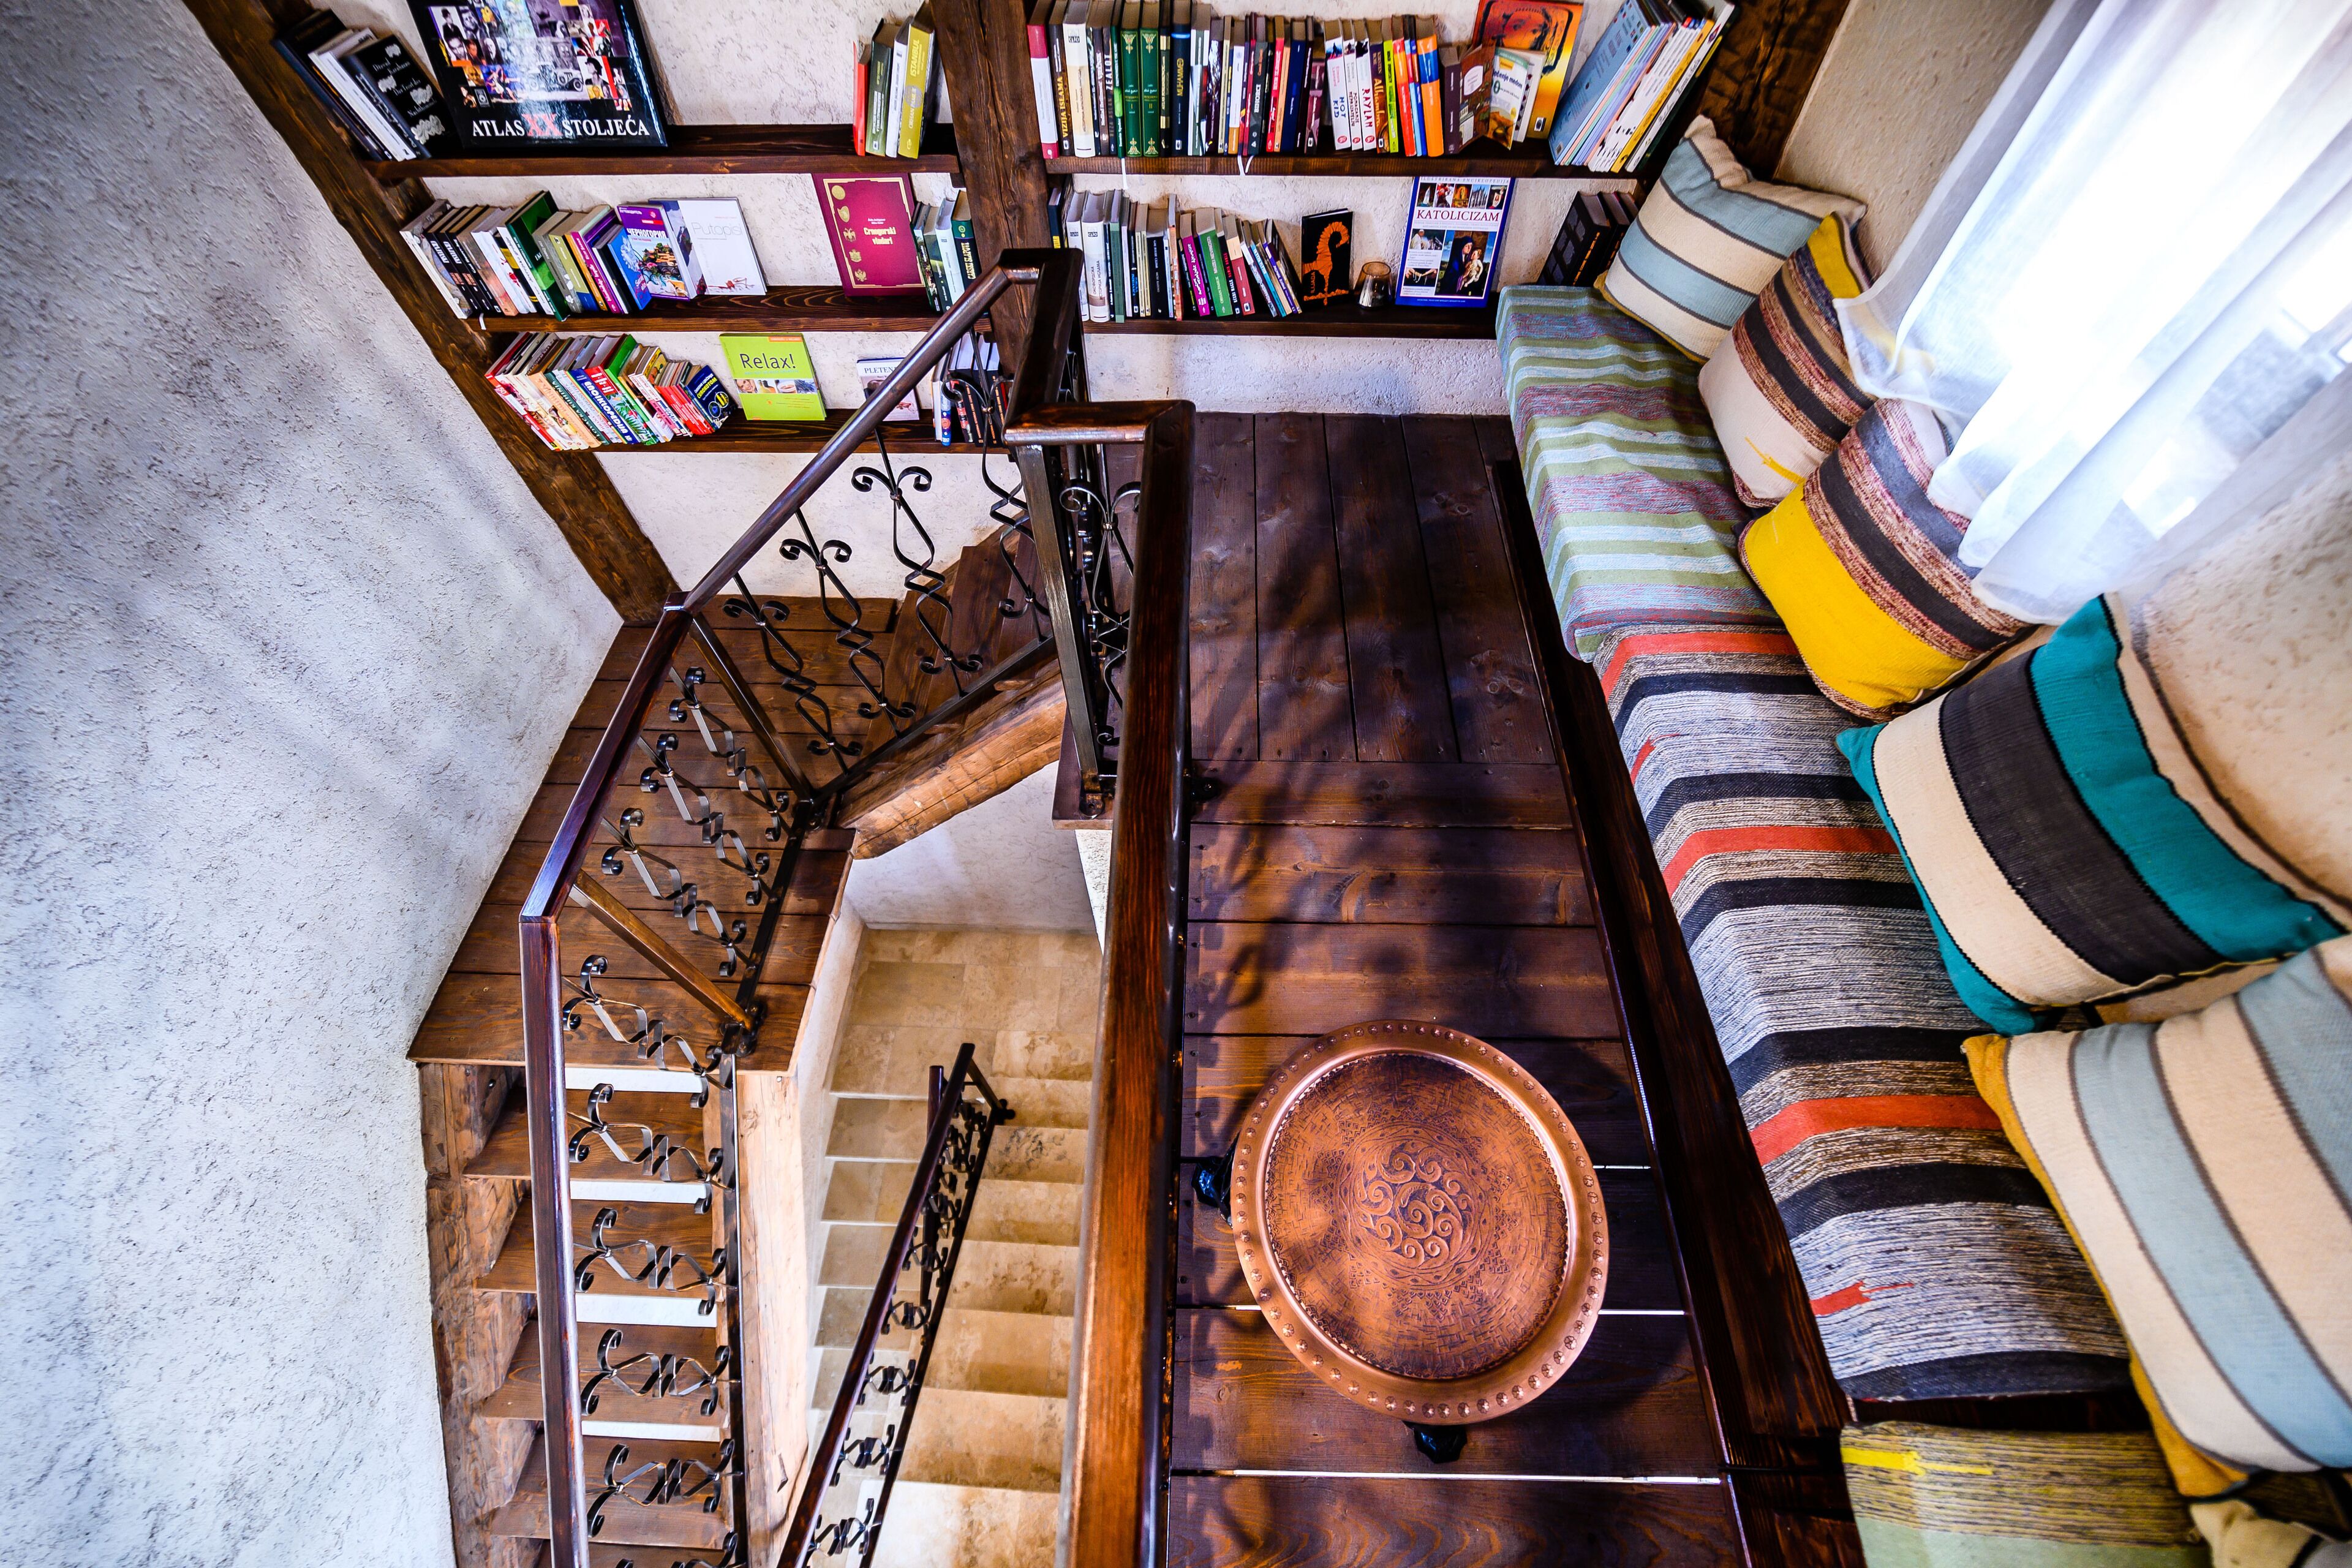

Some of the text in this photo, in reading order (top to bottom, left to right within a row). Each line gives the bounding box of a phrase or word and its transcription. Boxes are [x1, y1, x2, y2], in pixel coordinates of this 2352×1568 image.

[910, 39, 919, 77] ISTANBUL
[1104, 54, 1113, 90] ZEALOT
[1362, 88, 1373, 128] RAYLAN
[472, 113, 650, 137] ATLAS XX STOLJEĆA
[1416, 209, 1500, 222] KATOLICIZAM
[626, 228, 667, 238] ЧЕРНОГОРИЯ
[691, 222, 743, 238] Putopisi
[739, 353, 796, 369] Relax!
